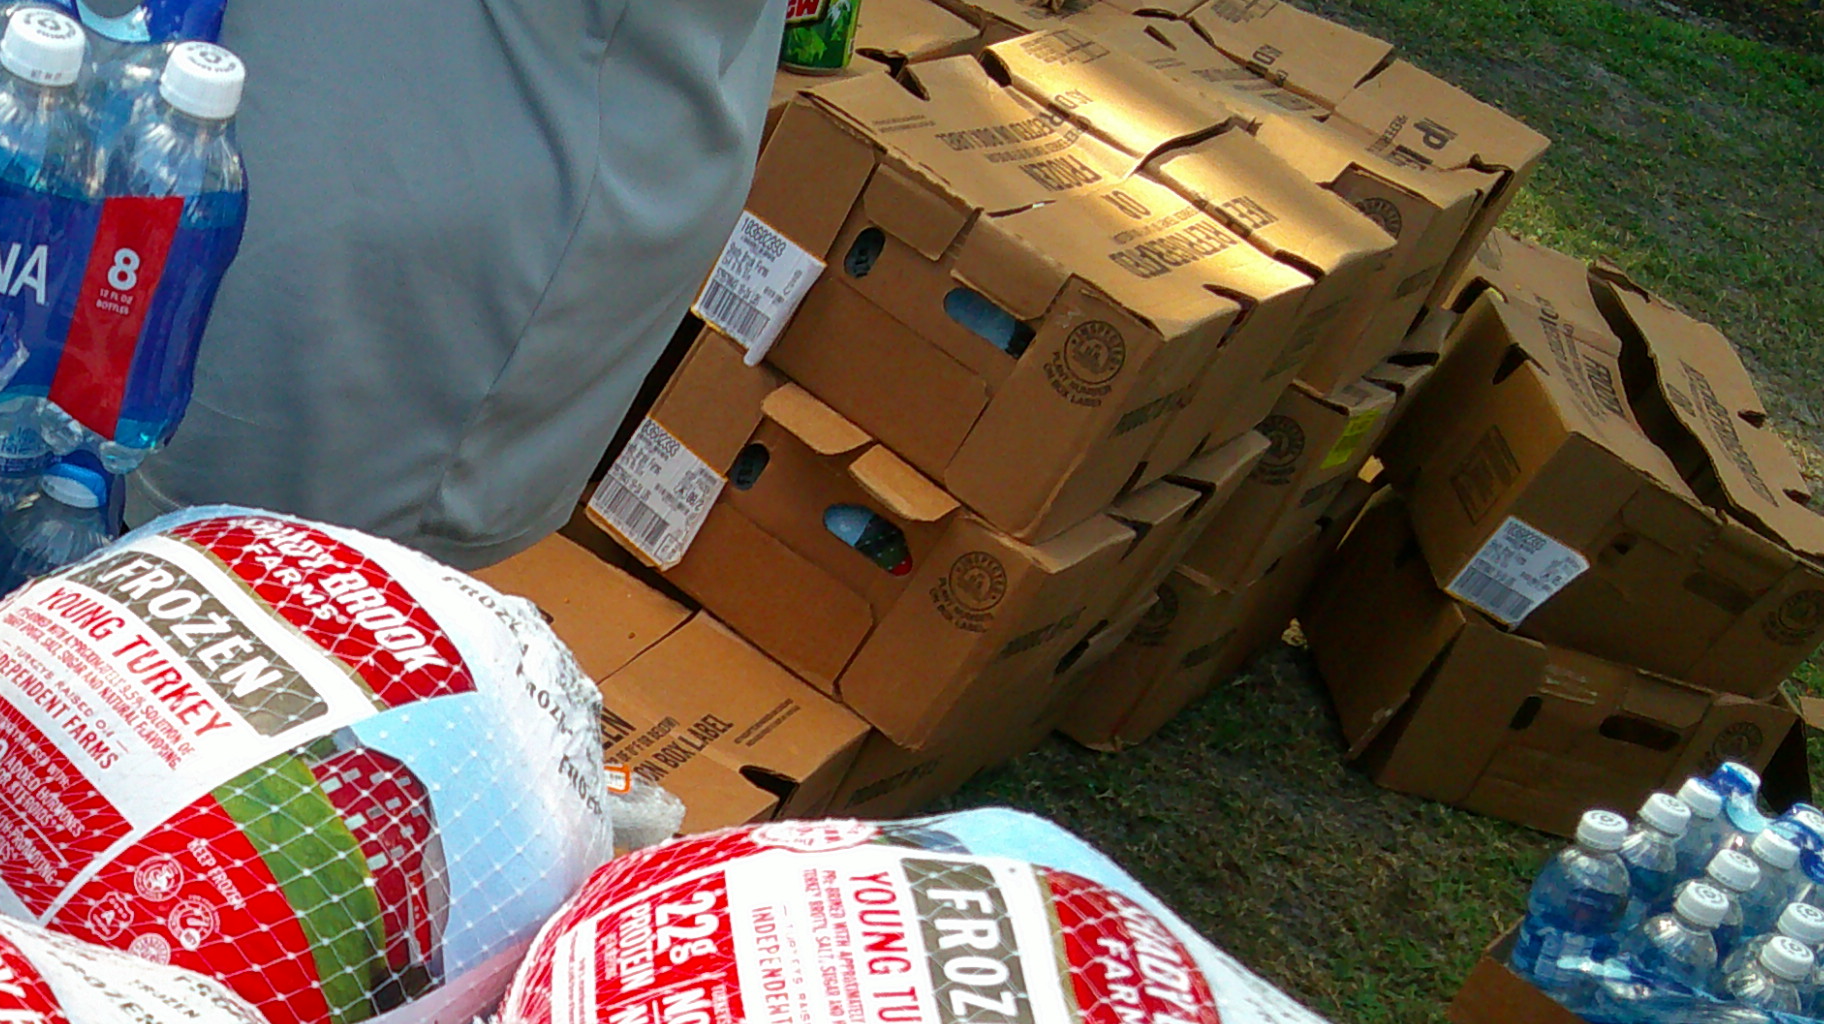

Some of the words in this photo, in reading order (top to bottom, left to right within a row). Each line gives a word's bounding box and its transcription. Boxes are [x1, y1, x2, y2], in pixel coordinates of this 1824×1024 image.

[1018, 154, 1103, 192] FROZEN
[95, 298, 130, 316] BOTTLES
[99, 287, 110, 298] 12
[106, 246, 142, 292] 8
[243, 543, 336, 623] FARMS
[97, 559, 283, 700] FROZEN
[320, 569, 445, 674] BROOK
[37, 586, 126, 642] YOUNG
[112, 633, 233, 737] TURKEY
[62, 715, 120, 770] FARMS
[652, 733, 696, 770] BOX
[676, 713, 734, 753] LABEL
[186, 838, 215, 867] KEEP
[206, 860, 247, 912] FROZEN
[619, 902, 656, 993] PROTEIN
[655, 889, 720, 965] 22g
[848, 871, 912, 975] YOUNG
[751, 906, 793, 1024] INDEPENDENT
